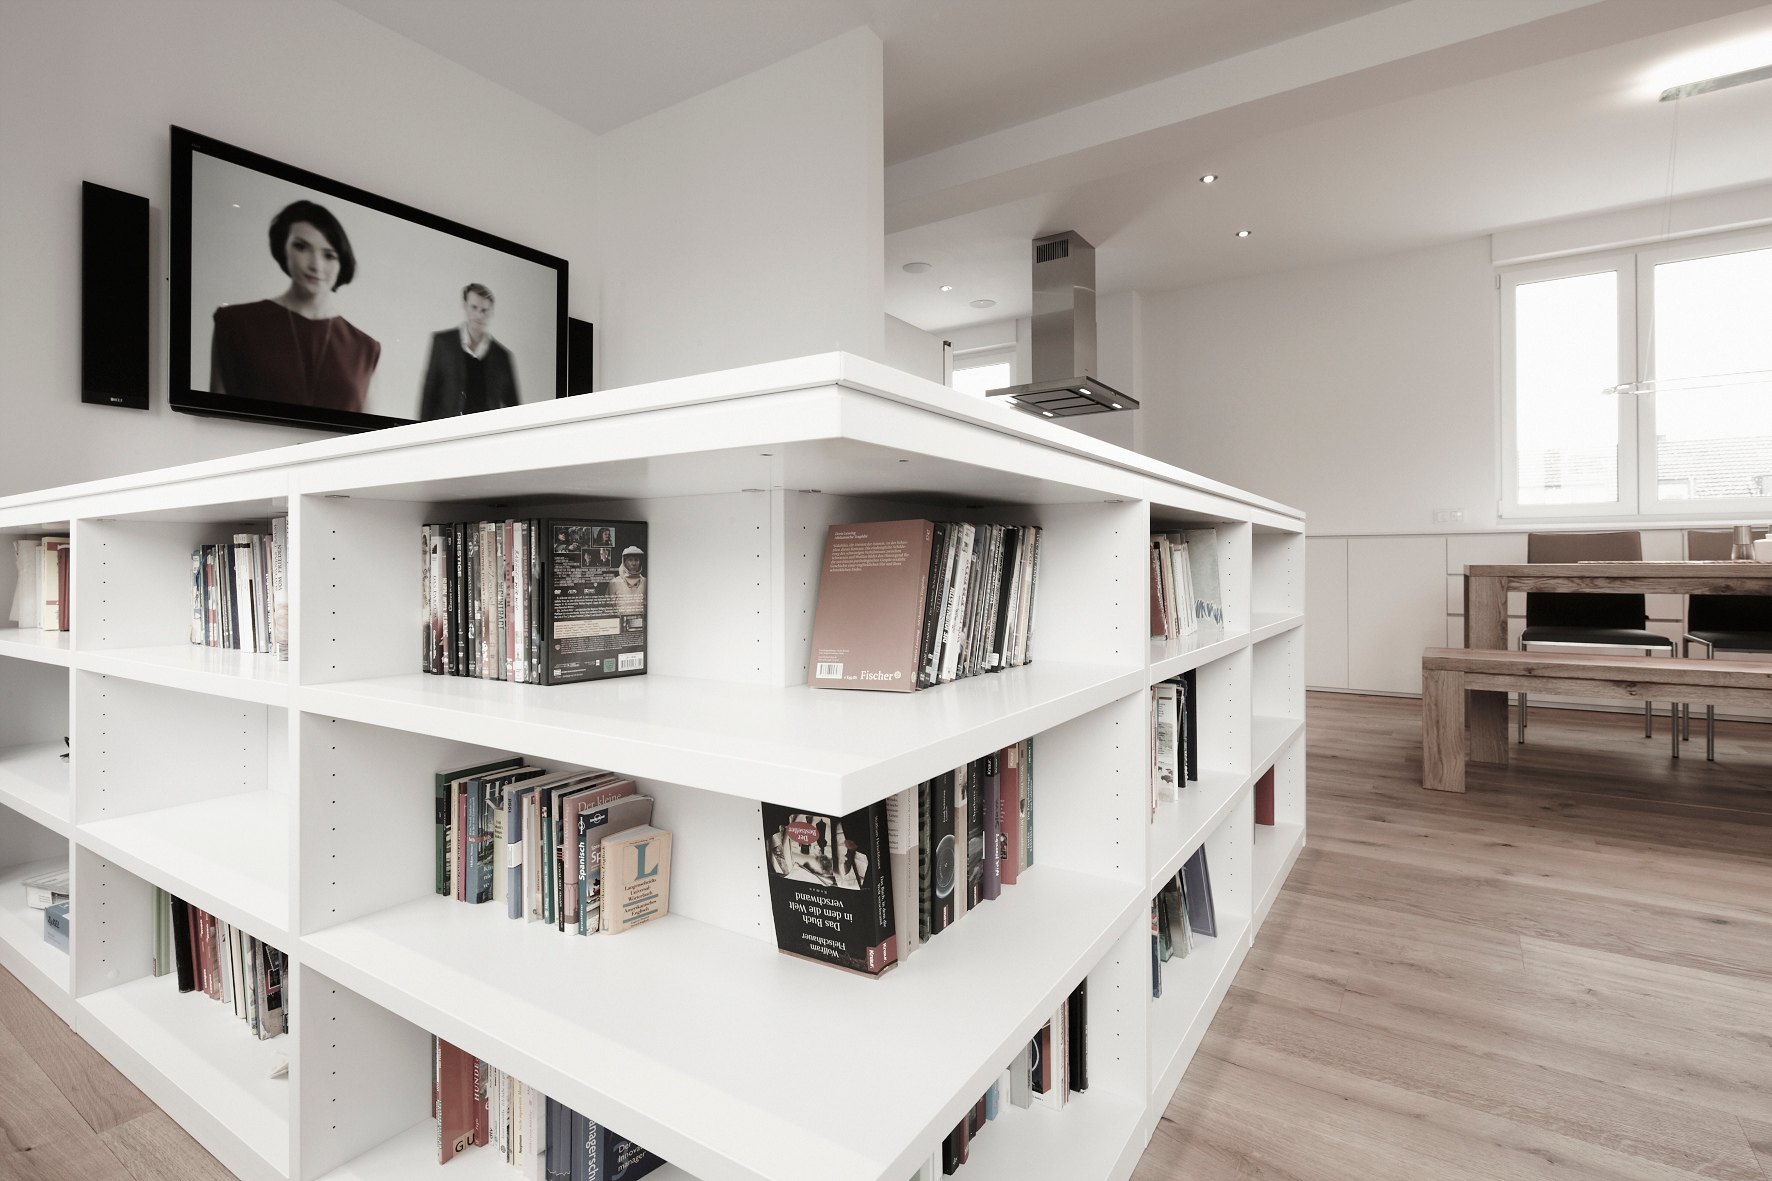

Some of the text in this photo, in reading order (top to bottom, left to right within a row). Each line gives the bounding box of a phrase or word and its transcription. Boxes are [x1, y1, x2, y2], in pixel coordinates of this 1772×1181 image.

[861, 671, 893, 681] Fischer
[578, 793, 622, 812] Der kleine
[788, 827, 817, 837] Bestseller
[578, 841, 586, 881] Spanisch
[634, 842, 659, 881] L
[795, 892, 844, 908] verschwand
[789, 901, 853, 923] in dem die Welt
[802, 914, 841, 932] Das Buch
[801, 933, 846, 951] Fleischhauer
[810, 944, 840, 958] Wolfram
[618, 1142, 632, 1154] Der
[617, 1151, 647, 1172] manager
